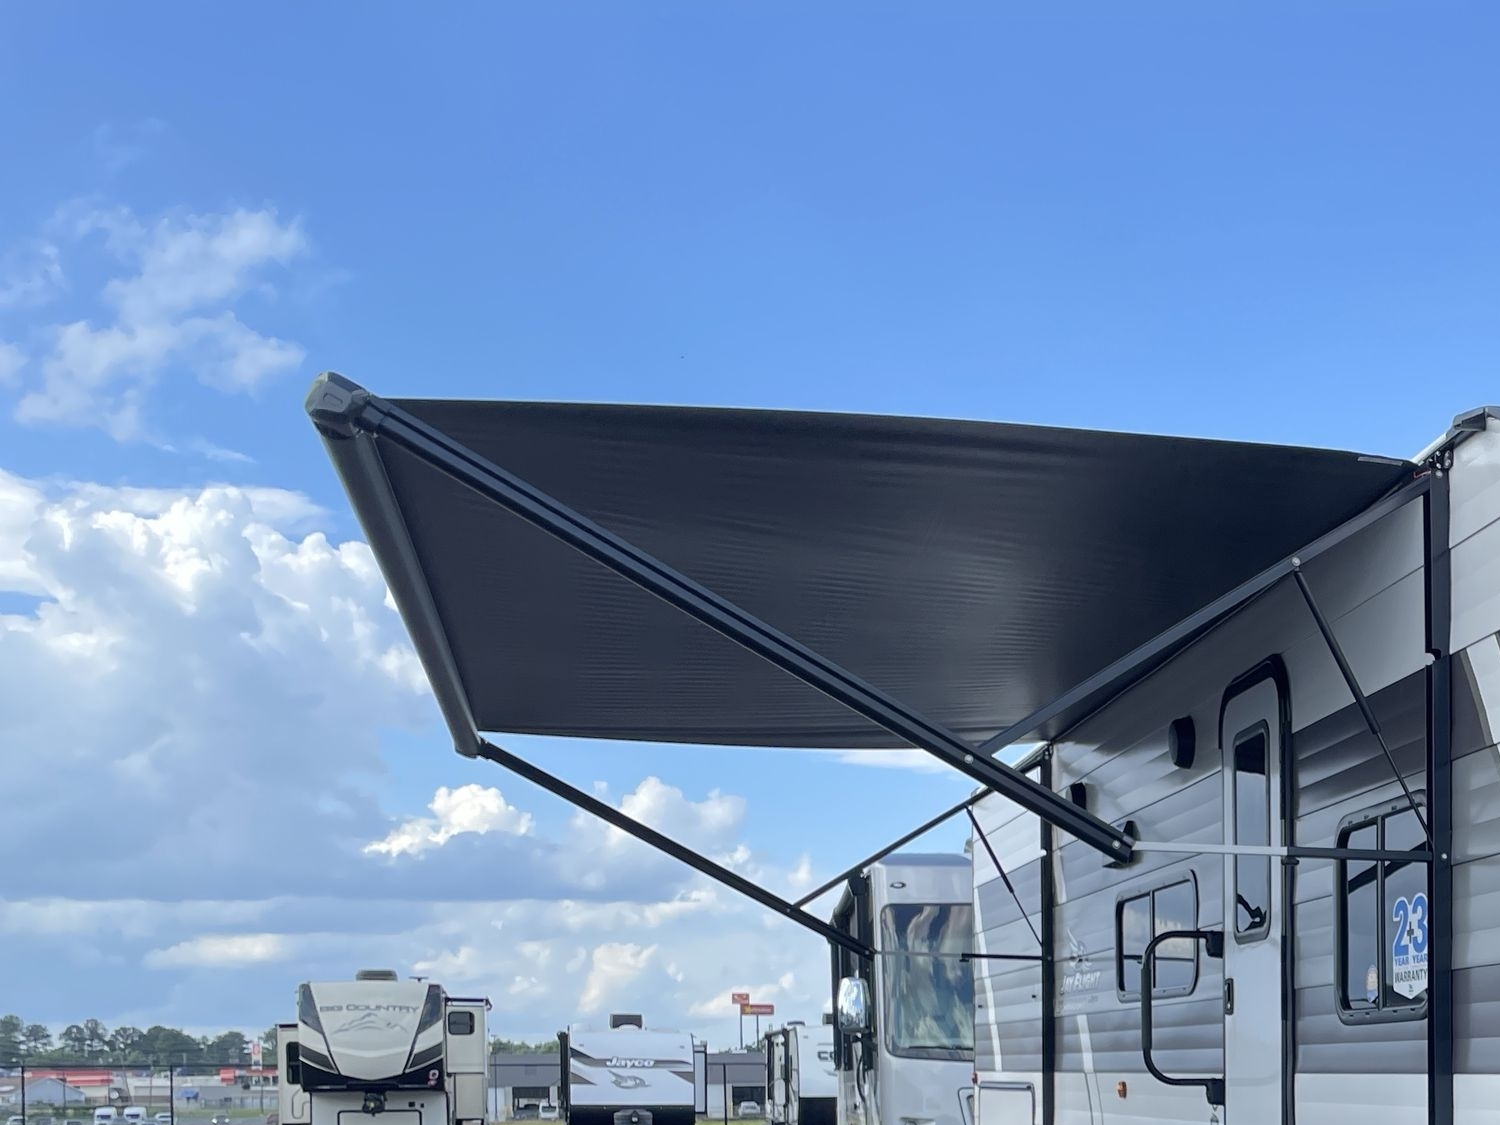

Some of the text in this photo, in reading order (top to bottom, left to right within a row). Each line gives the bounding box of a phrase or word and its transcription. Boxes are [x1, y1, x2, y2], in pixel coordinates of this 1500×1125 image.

[1395, 956, 1410, 967] YEAR
[1395, 969, 1428, 983] WARRANTY
[320, 1003, 420, 1013] BIG COUNTRY
[606, 1056, 655, 1068] Jayco
